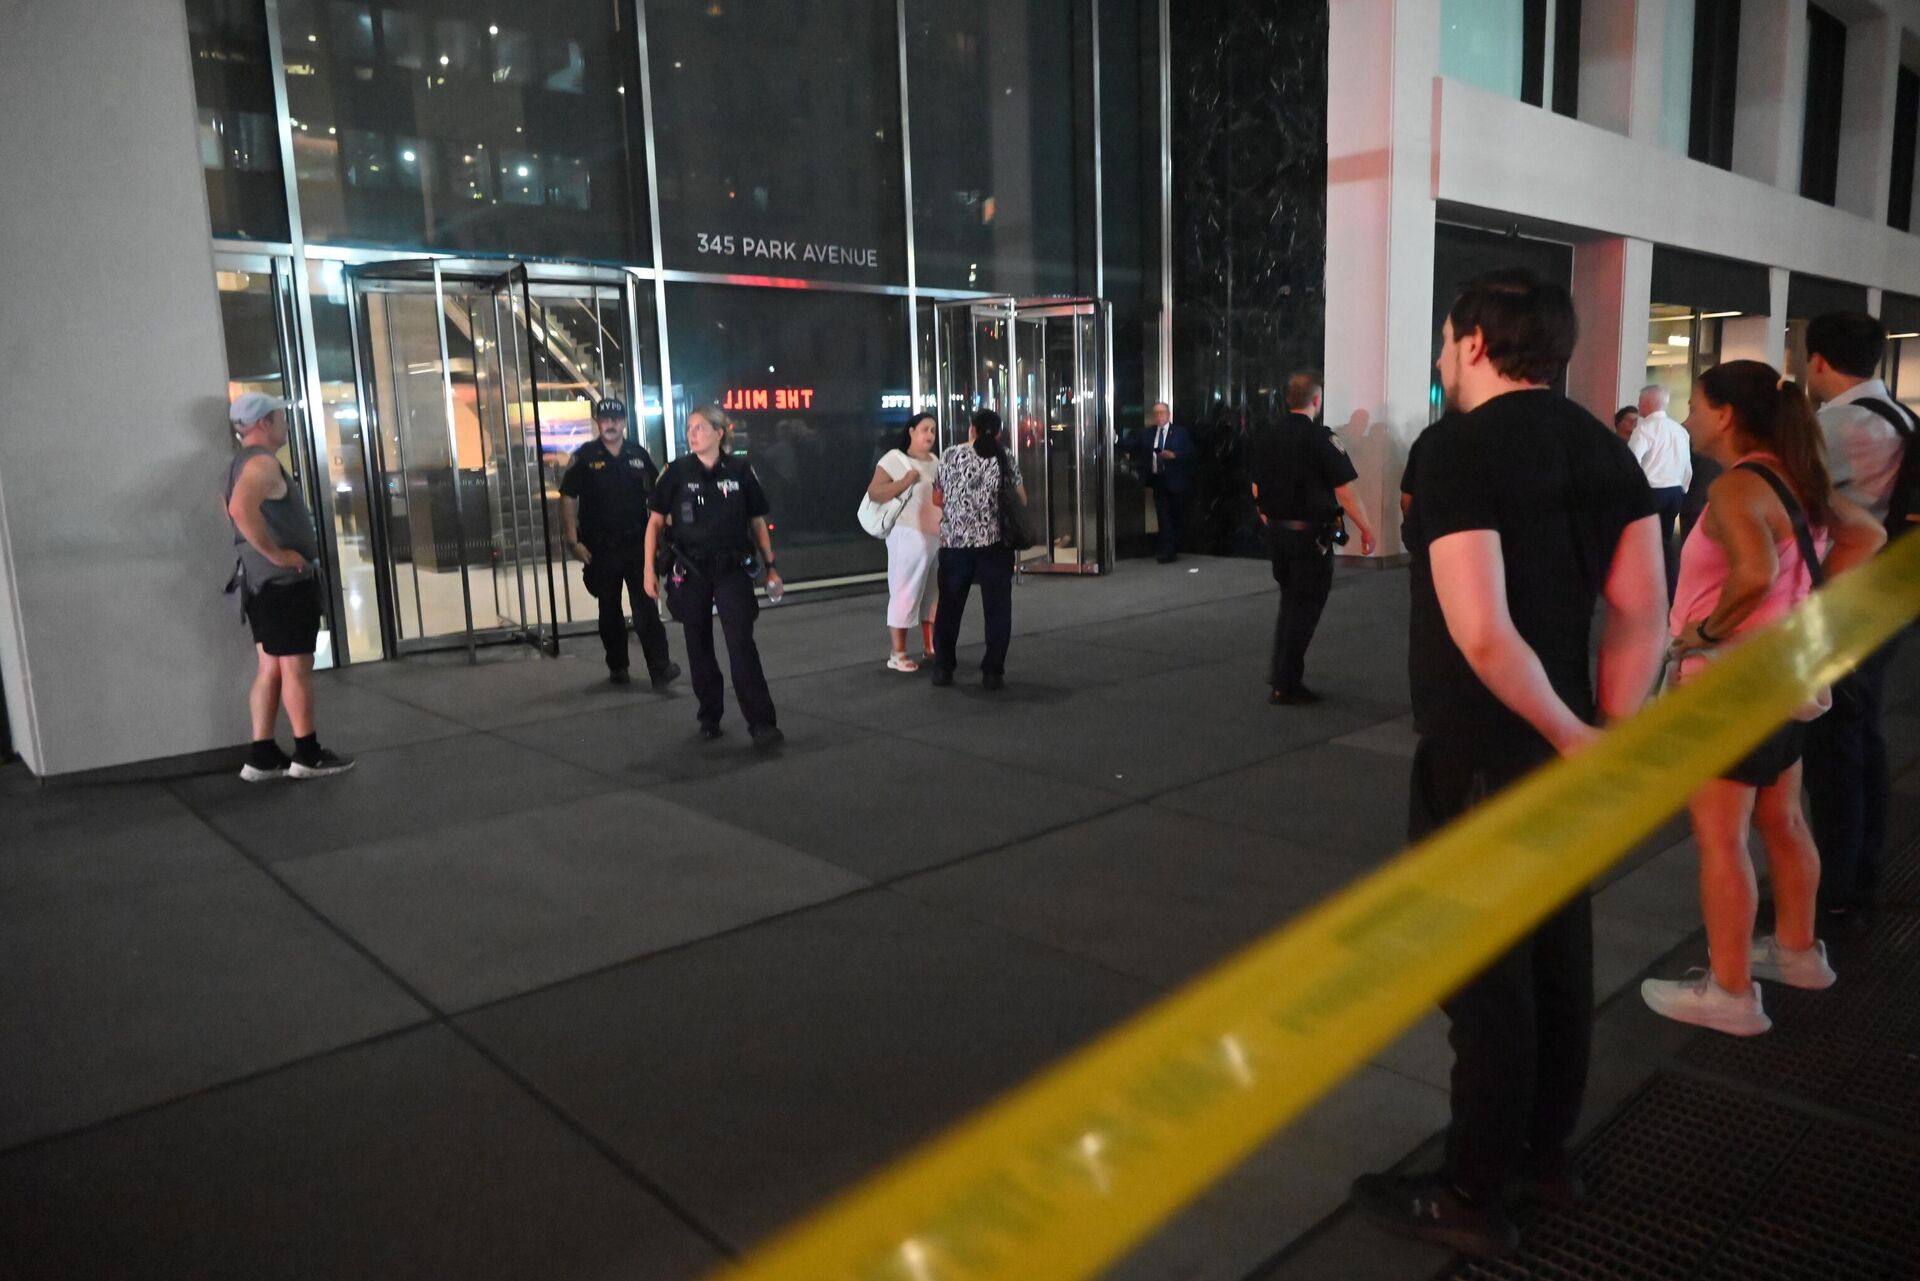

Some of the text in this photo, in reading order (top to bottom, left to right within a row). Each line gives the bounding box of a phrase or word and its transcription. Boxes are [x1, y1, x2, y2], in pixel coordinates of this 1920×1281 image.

[697, 233, 878, 267] 345 PARK AVENUE
[600, 402, 622, 412] NYPD
